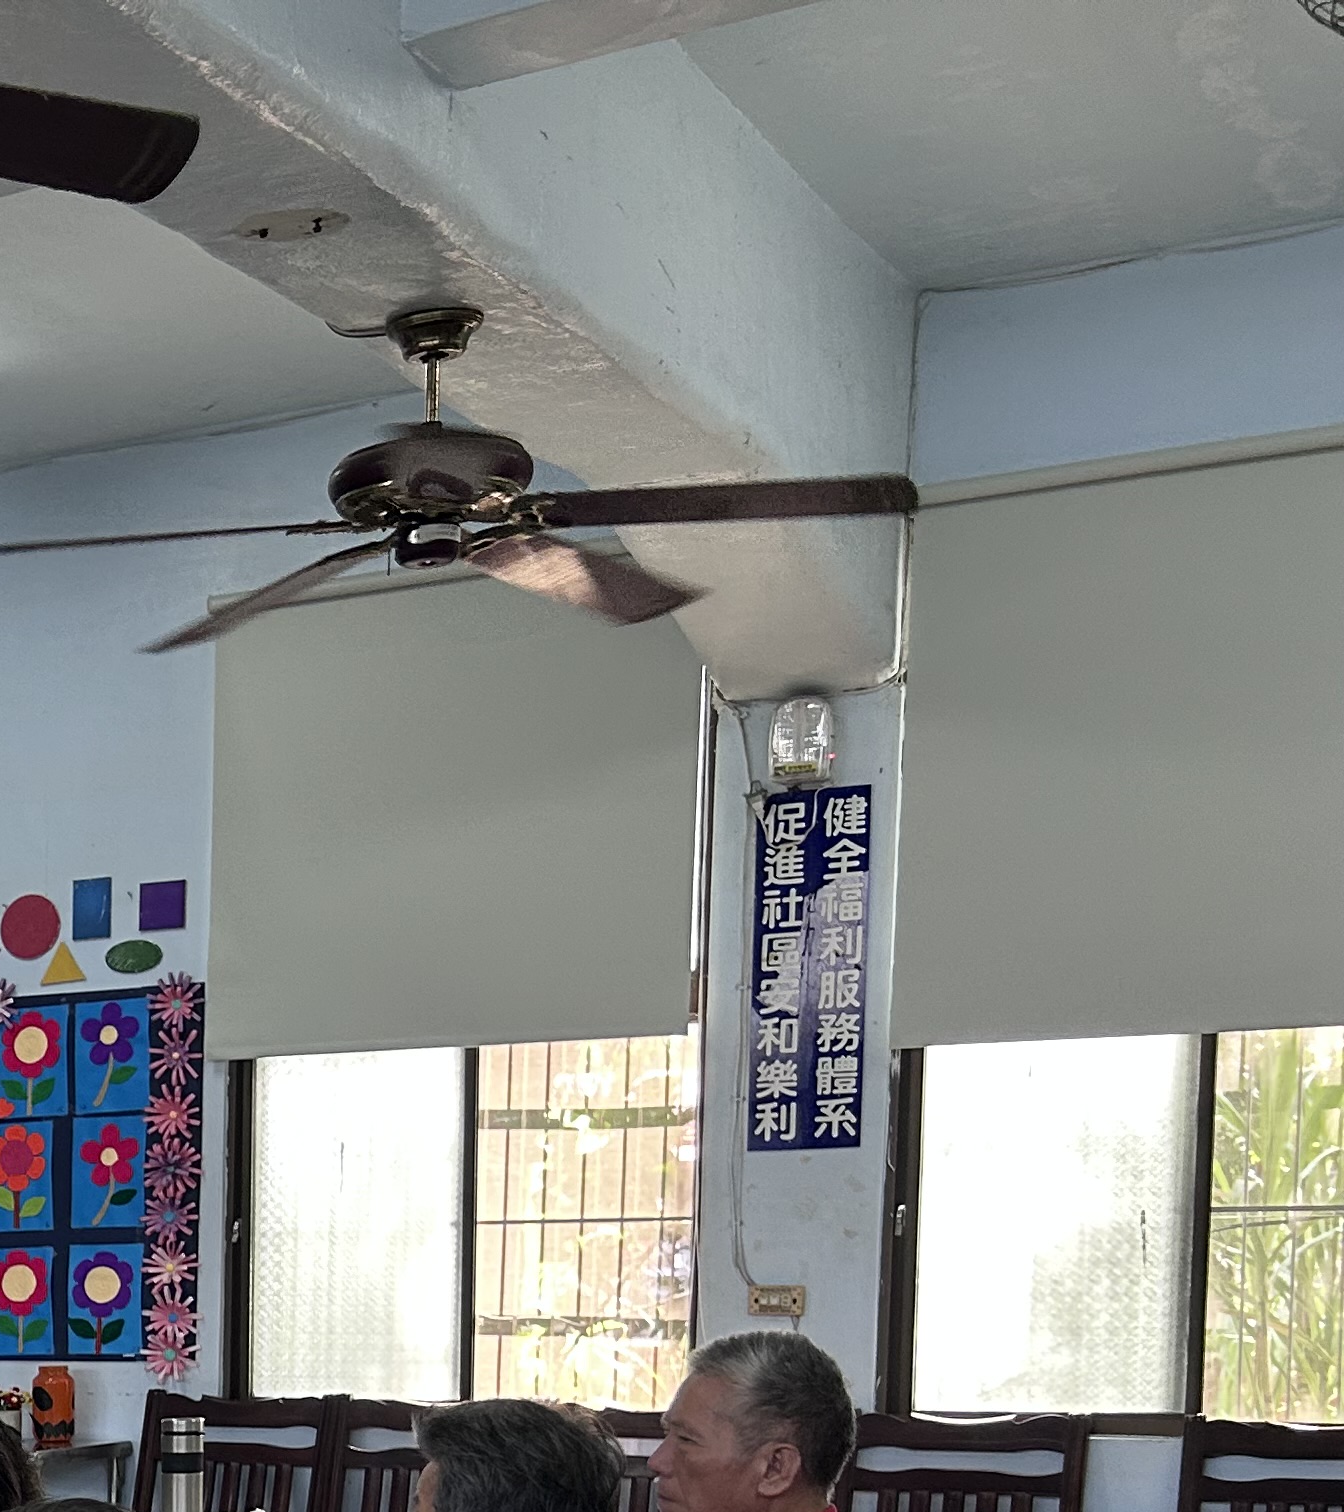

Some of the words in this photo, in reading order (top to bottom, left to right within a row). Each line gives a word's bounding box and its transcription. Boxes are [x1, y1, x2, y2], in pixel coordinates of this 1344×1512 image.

[754, 802, 806, 1142] 促進社區安和樂利
[814, 794, 868, 1138] 健全福利服務體系
